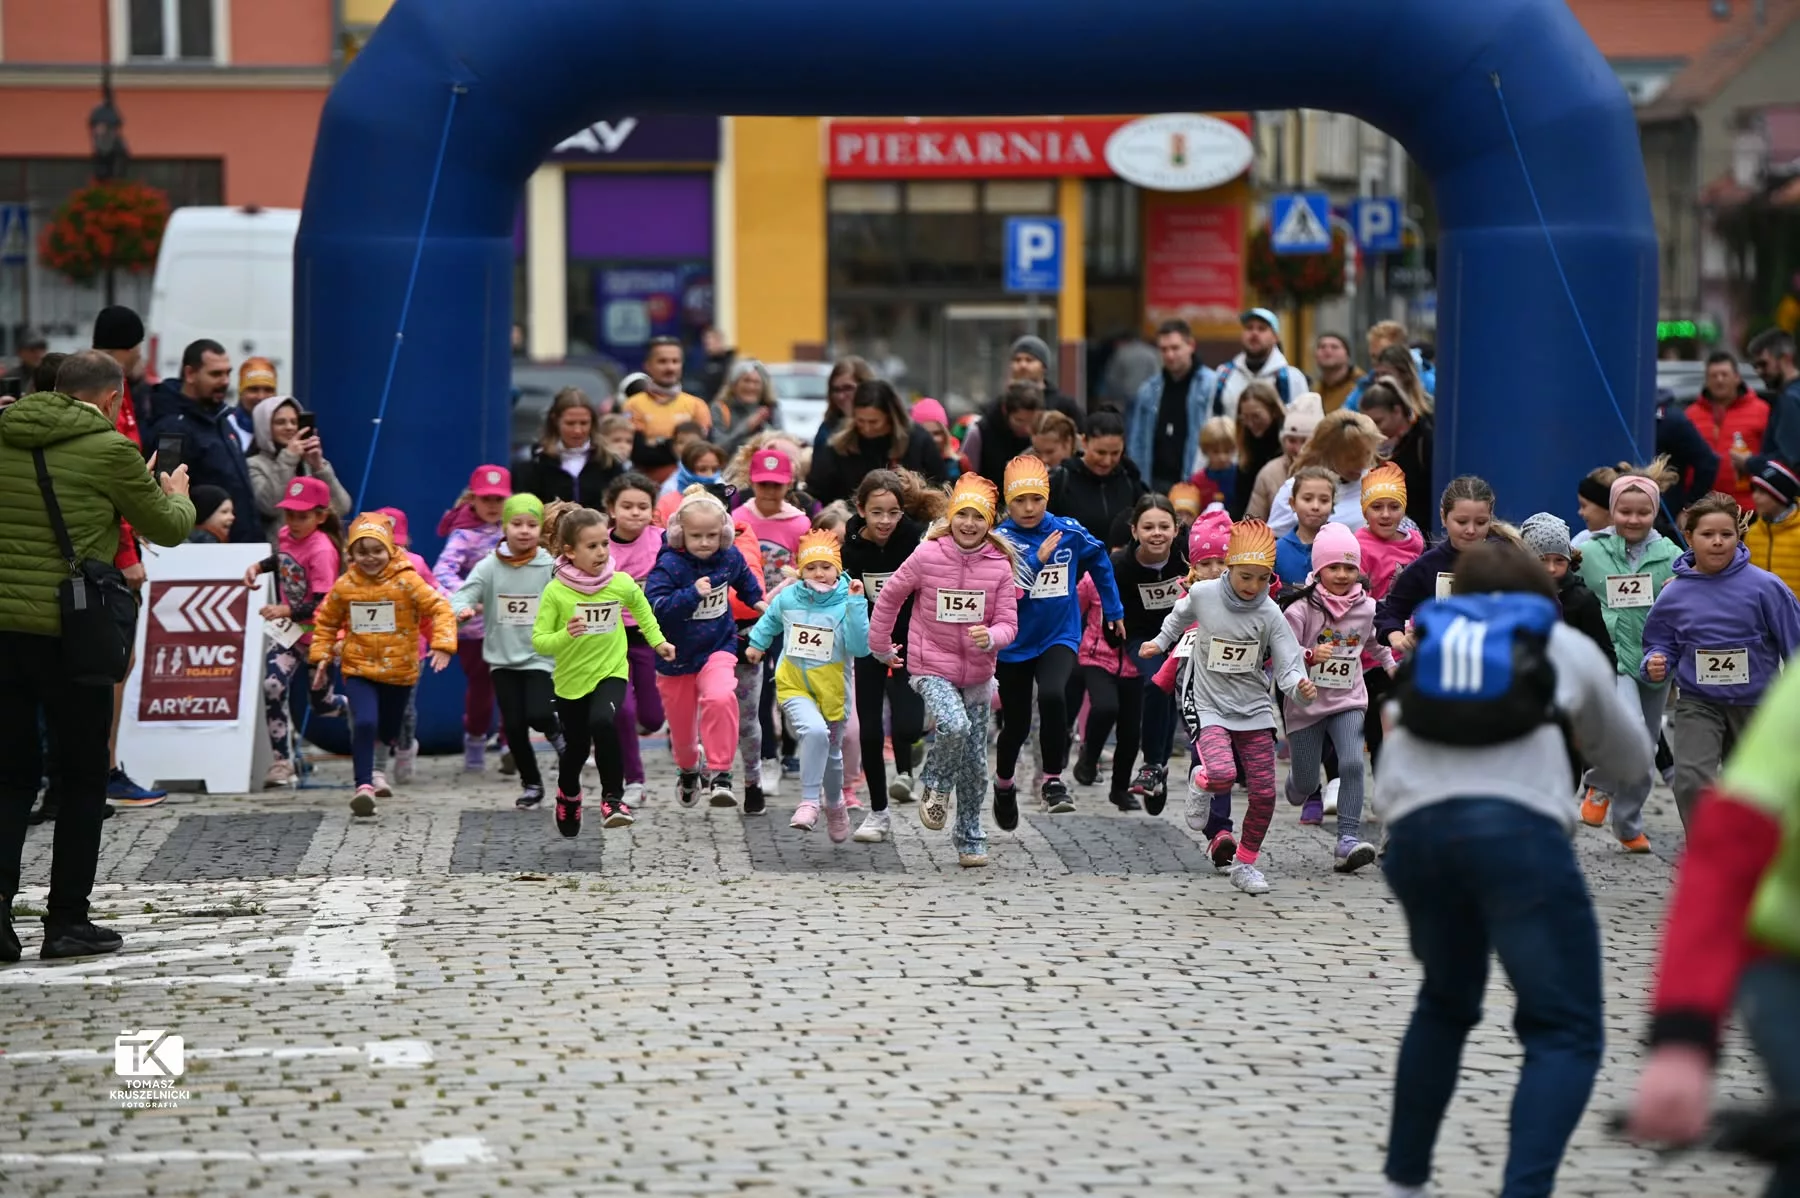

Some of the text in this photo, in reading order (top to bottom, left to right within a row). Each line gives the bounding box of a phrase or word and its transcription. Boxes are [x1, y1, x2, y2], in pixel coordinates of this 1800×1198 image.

[836, 131, 1095, 165] PIEKARNIA
[1361, 203, 1393, 246] P
[1018, 225, 1055, 270] P
[1041, 571, 1059, 585] 73
[1146, 585, 1178, 600] 194
[1618, 581, 1641, 595] 42
[507, 602, 528, 613] 62
[702, 592, 724, 608] 172
[944, 596, 977, 611] 154
[367, 609, 377, 621] 7
[585, 608, 611, 622] 117
[798, 631, 822, 647] 84
[187, 645, 237, 666] WC
[1222, 646, 1247, 661] 57
[1319, 662, 1350, 676] 148
[1708, 656, 1735, 671] 24
[186, 668, 234, 676] TOALETY
[147, 696, 231, 715] ARYZTA
